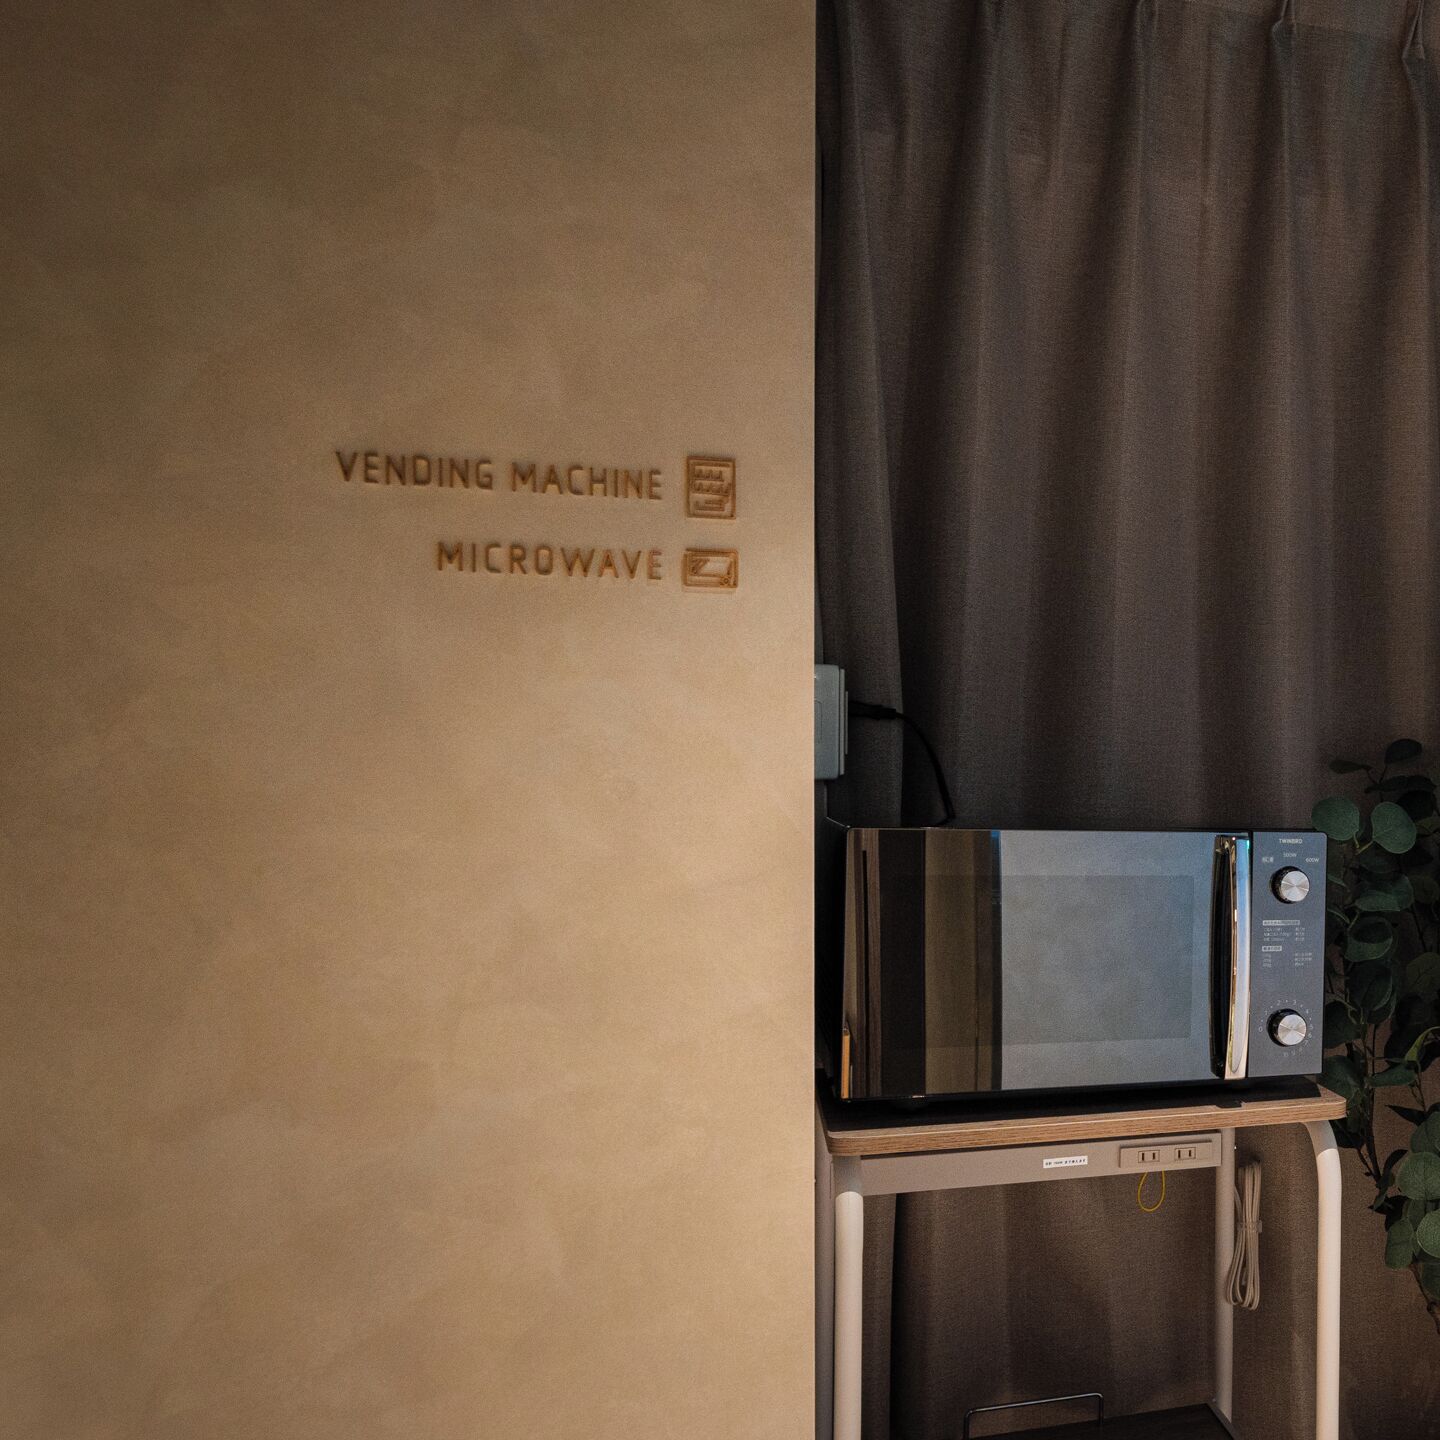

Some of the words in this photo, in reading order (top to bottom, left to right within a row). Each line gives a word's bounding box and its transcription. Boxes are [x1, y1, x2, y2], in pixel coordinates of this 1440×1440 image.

[335, 450, 494, 491] VENDING
[510, 461, 662, 501] MACHINE
[436, 540, 663, 581] MICROWAVE
